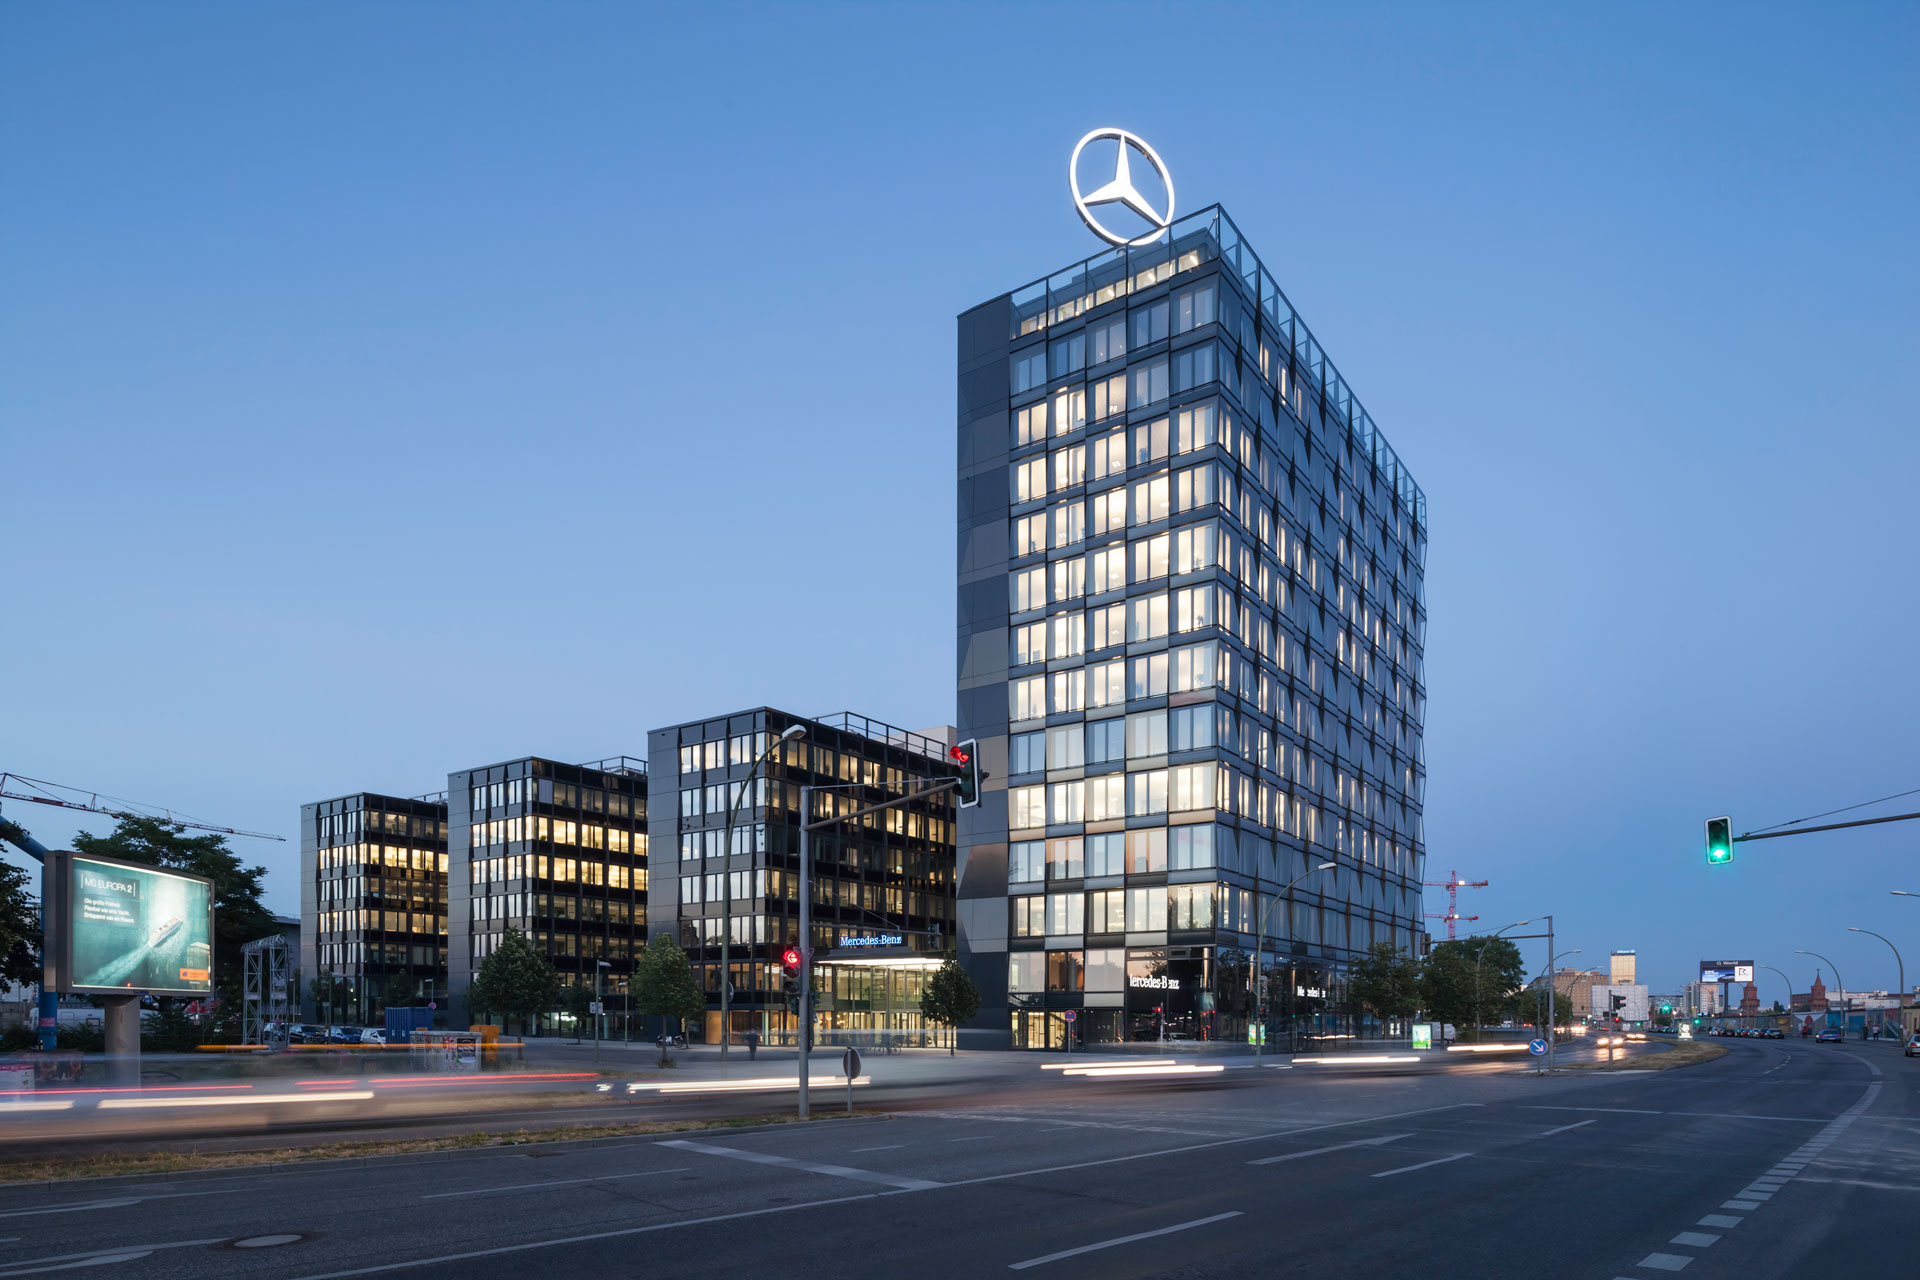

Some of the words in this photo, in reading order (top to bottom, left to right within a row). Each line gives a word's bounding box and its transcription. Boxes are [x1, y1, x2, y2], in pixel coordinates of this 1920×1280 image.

[85, 877, 96, 888] MS
[98, 880, 126, 892] EUROPA
[127, 884, 132, 893] 2
[840, 934, 902, 946] Mercedes-Benz
